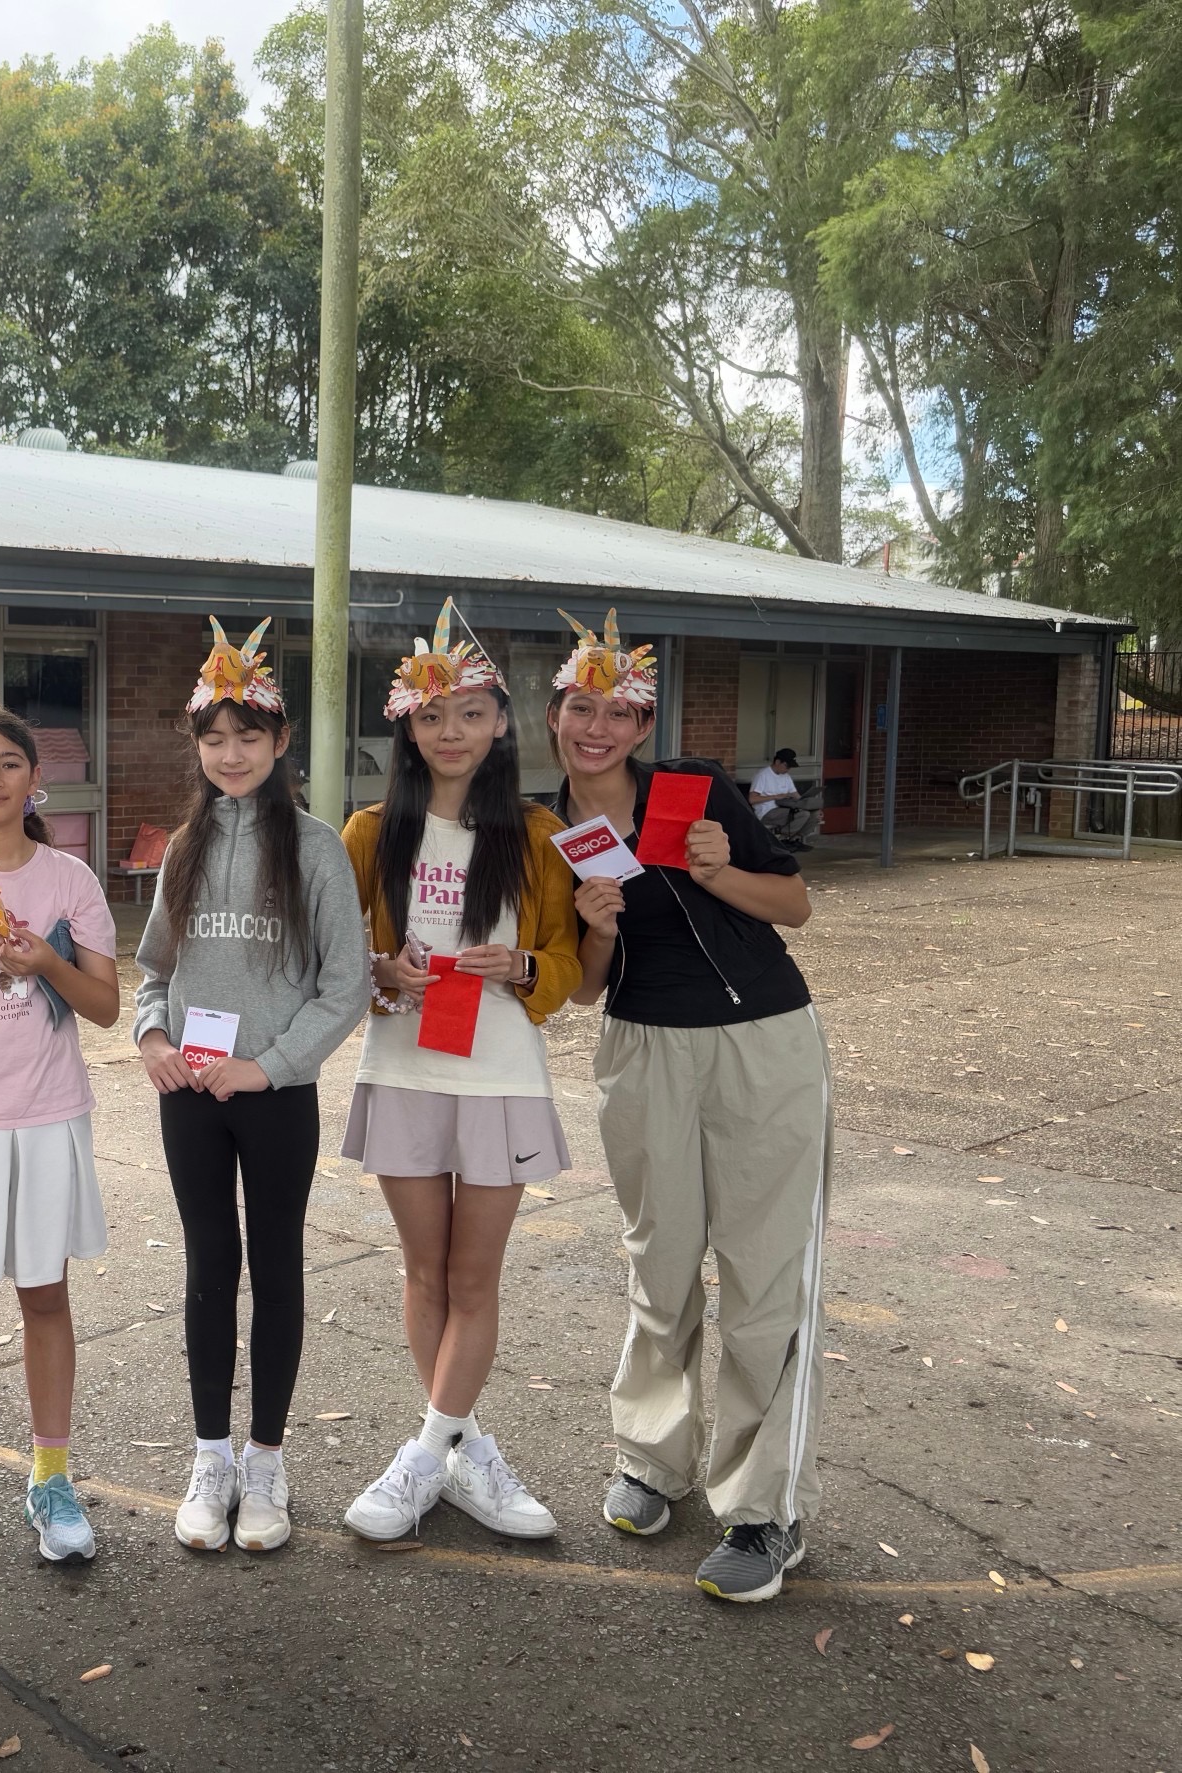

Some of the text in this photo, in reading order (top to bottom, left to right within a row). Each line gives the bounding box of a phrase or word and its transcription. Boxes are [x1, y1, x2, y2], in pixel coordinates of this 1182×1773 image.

[569, 835, 610, 857] coles
[418, 884, 466, 905] Par
[408, 916, 453, 926] NOUVELLE
[185, 1051, 220, 1064] cole
